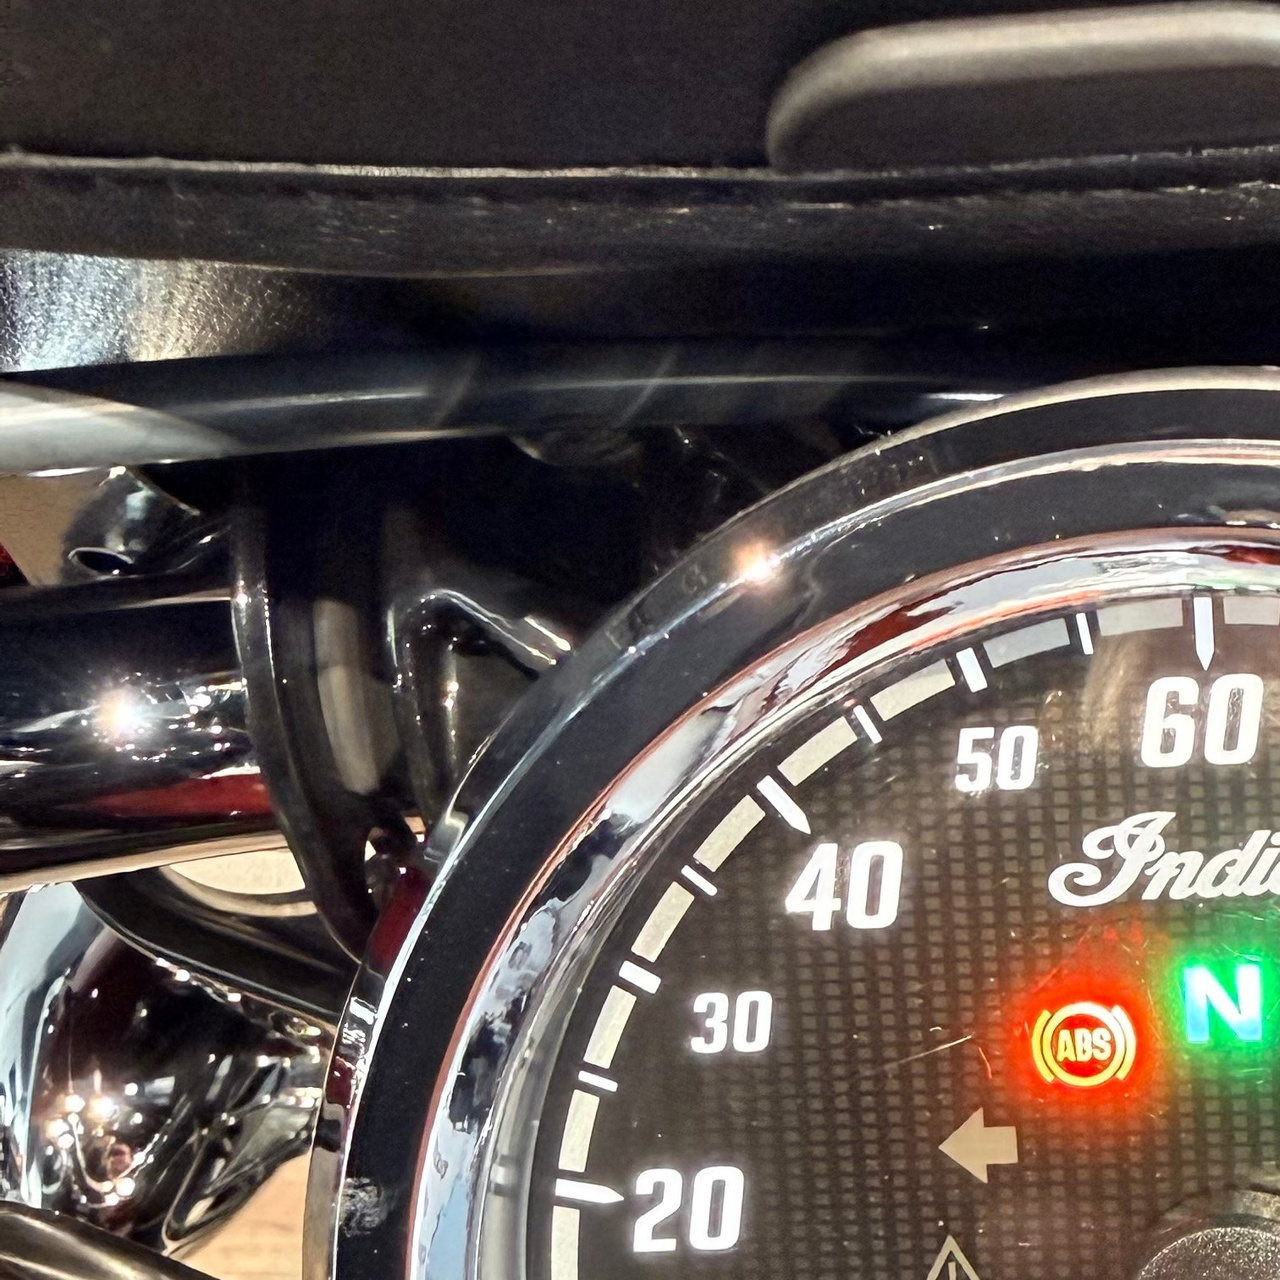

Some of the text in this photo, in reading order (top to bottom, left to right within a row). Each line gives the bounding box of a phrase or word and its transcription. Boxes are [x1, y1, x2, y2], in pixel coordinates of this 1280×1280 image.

[954, 725, 1039, 796] 50
[1140, 673, 1265, 768] 60
[784, 840, 903, 931] 40
[690, 990, 773, 1054] 30
[1183, 963, 1264, 1044] N
[1056, 1027, 1112, 1062] ABS
[633, 1165, 745, 1253] 20
